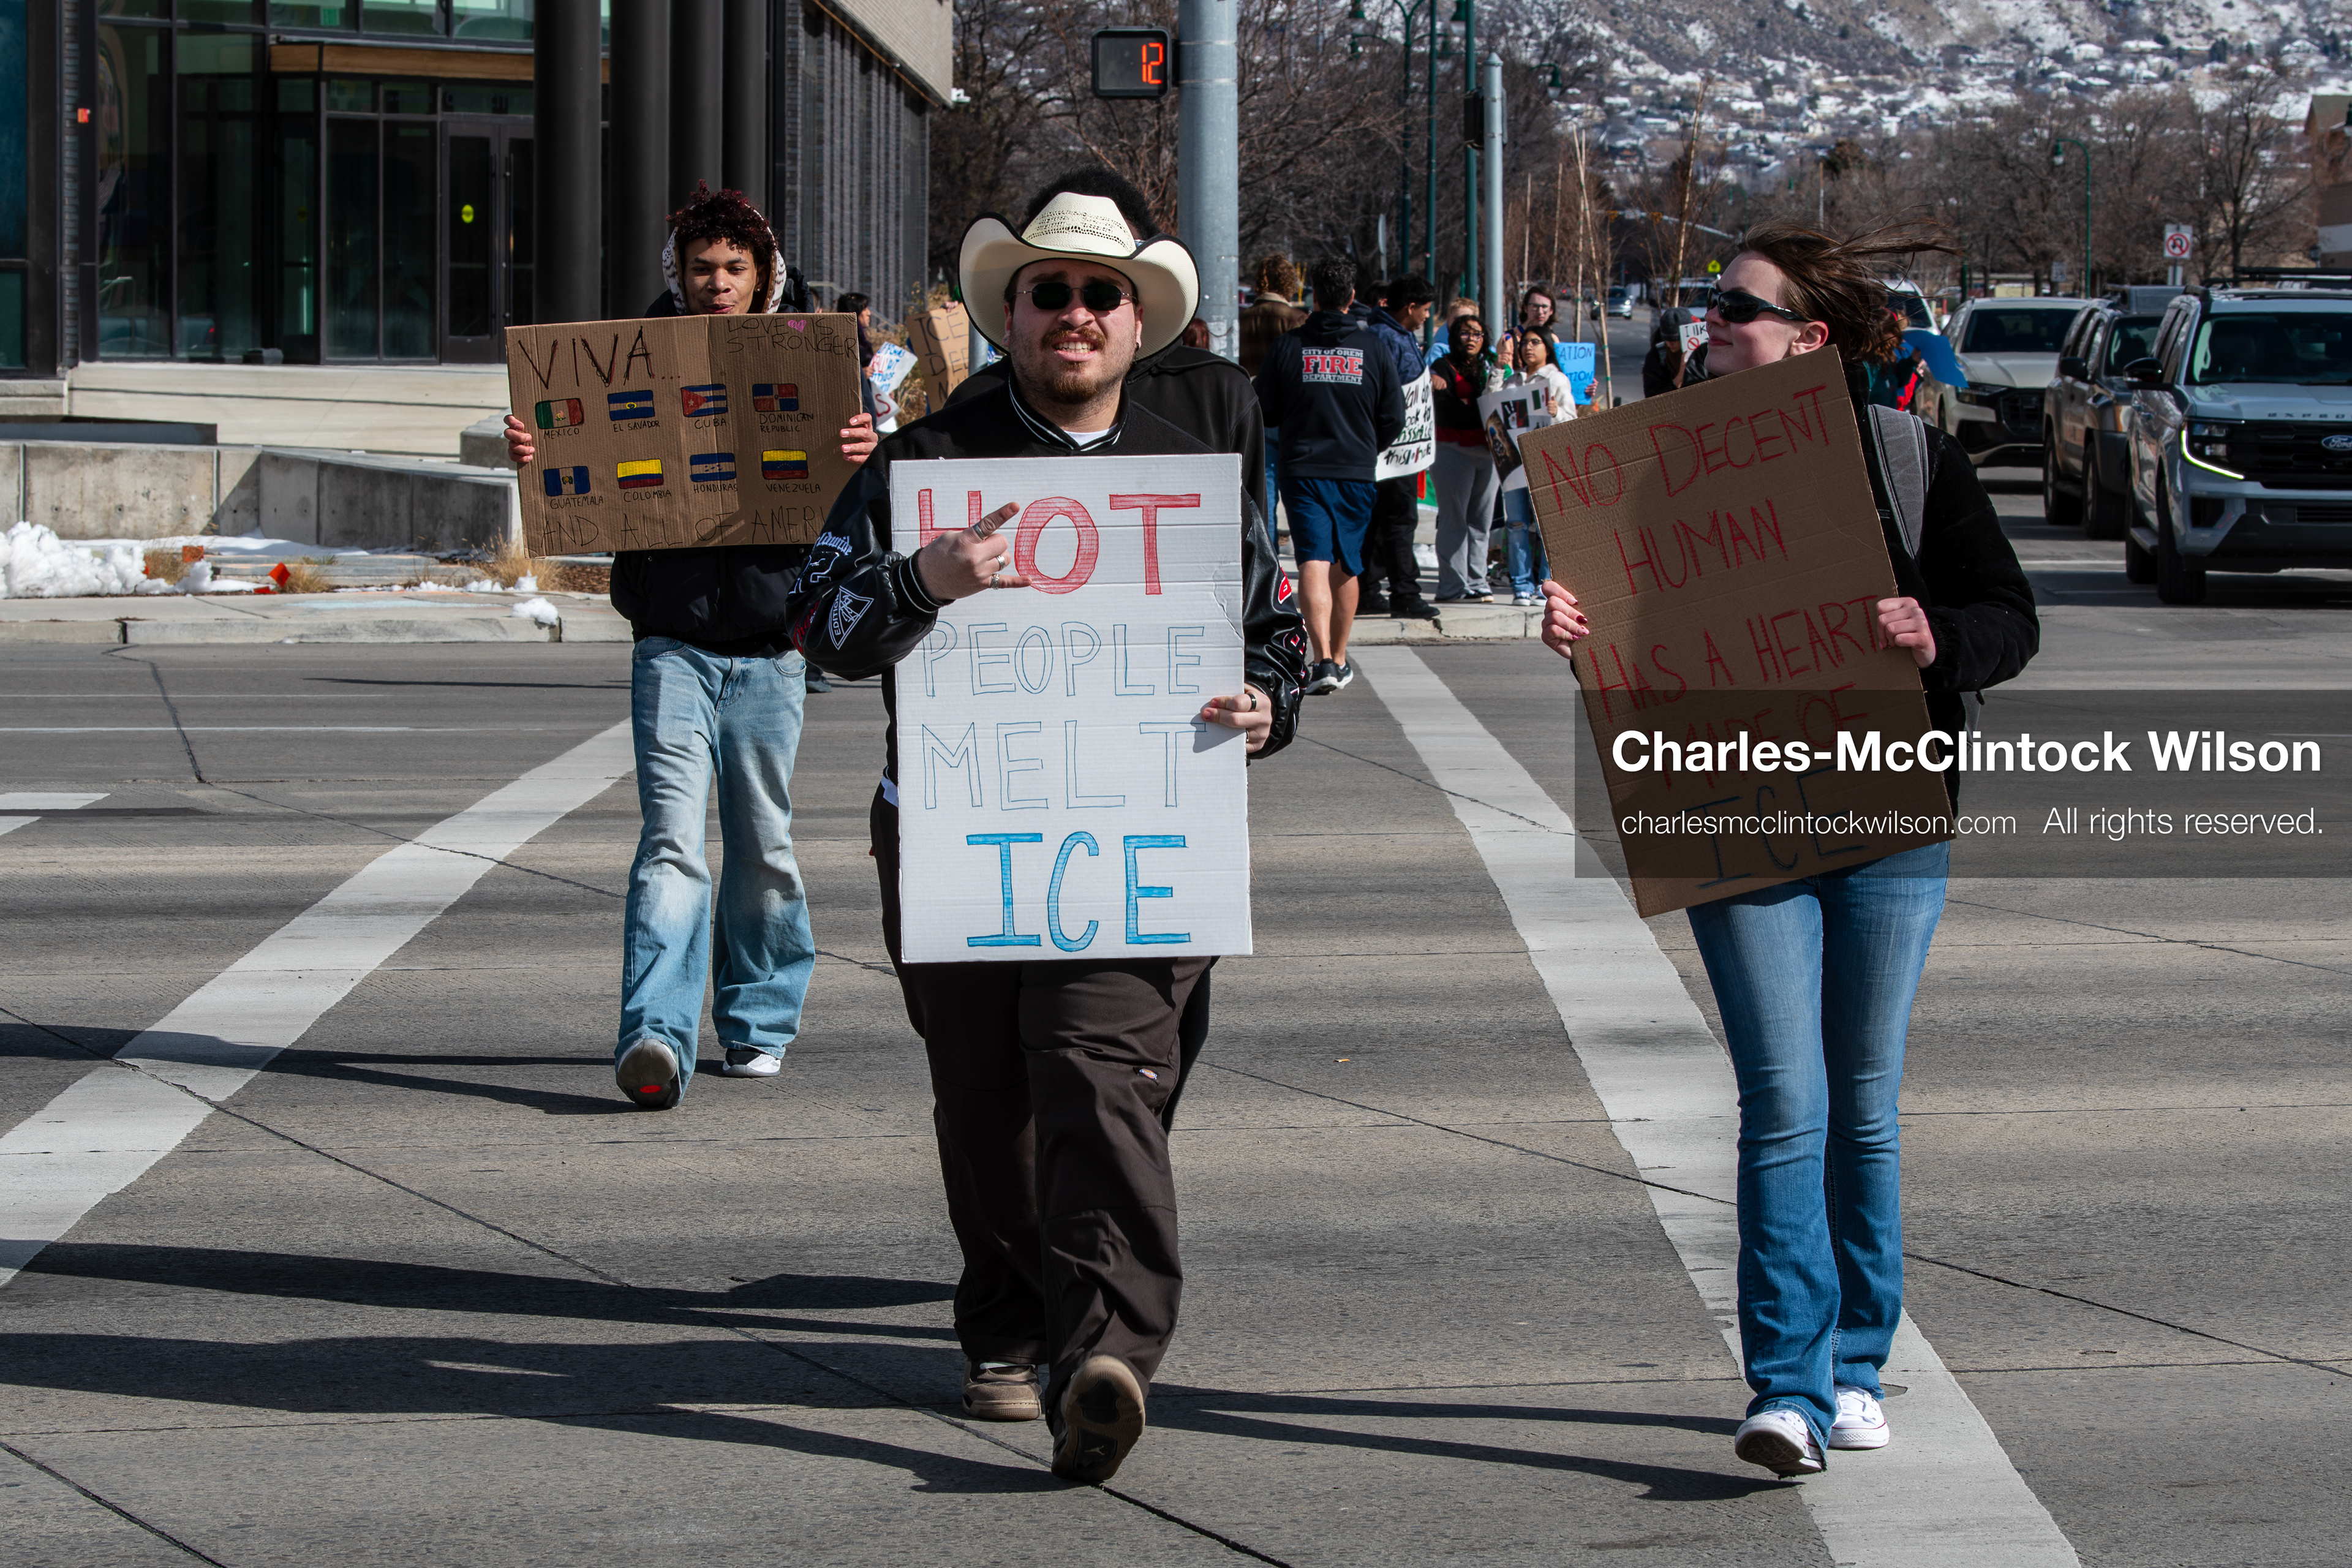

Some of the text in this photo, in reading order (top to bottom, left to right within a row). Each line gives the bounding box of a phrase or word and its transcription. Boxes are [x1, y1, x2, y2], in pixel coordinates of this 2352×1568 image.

[1142, 42, 1163, 84] 12
[727, 317, 834, 335] LOVE IS
[914, 311, 968, 356] ICE
[727, 334, 859, 360] STRONGER
[1558, 345, 1593, 361] ATION
[1302, 355, 1363, 376] FIRE
[1302, 374, 1362, 382] DEPARTMENT
[613, 420, 660, 432] EL SAVADOR
[695, 418, 727, 429] CUBA
[759, 413, 814, 424] DOMINICAN
[543, 428, 579, 440] MEXICO
[1541, 383, 1826, 516] NO DECENT
[624, 489, 671, 502] COLOMBIA
[693, 483, 738, 493] HONDURAS
[766, 483, 821, 494] VENEZUELA
[550, 496, 603, 509] GUATEMALA
[540, 515, 599, 552] AND
[620, 513, 683, 549] ALL
[695, 512, 734, 543] OF
[1615, 498, 1789, 597] HUMAN
[922, 621, 1205, 697] PEOPLE
[1589, 596, 1878, 724] HAS A HEART
[1797, 682, 1868, 748] OF
[922, 720, 1207, 810] MELT
[1677, 764, 1869, 889] ICE
[966, 831, 1192, 952] ICE
